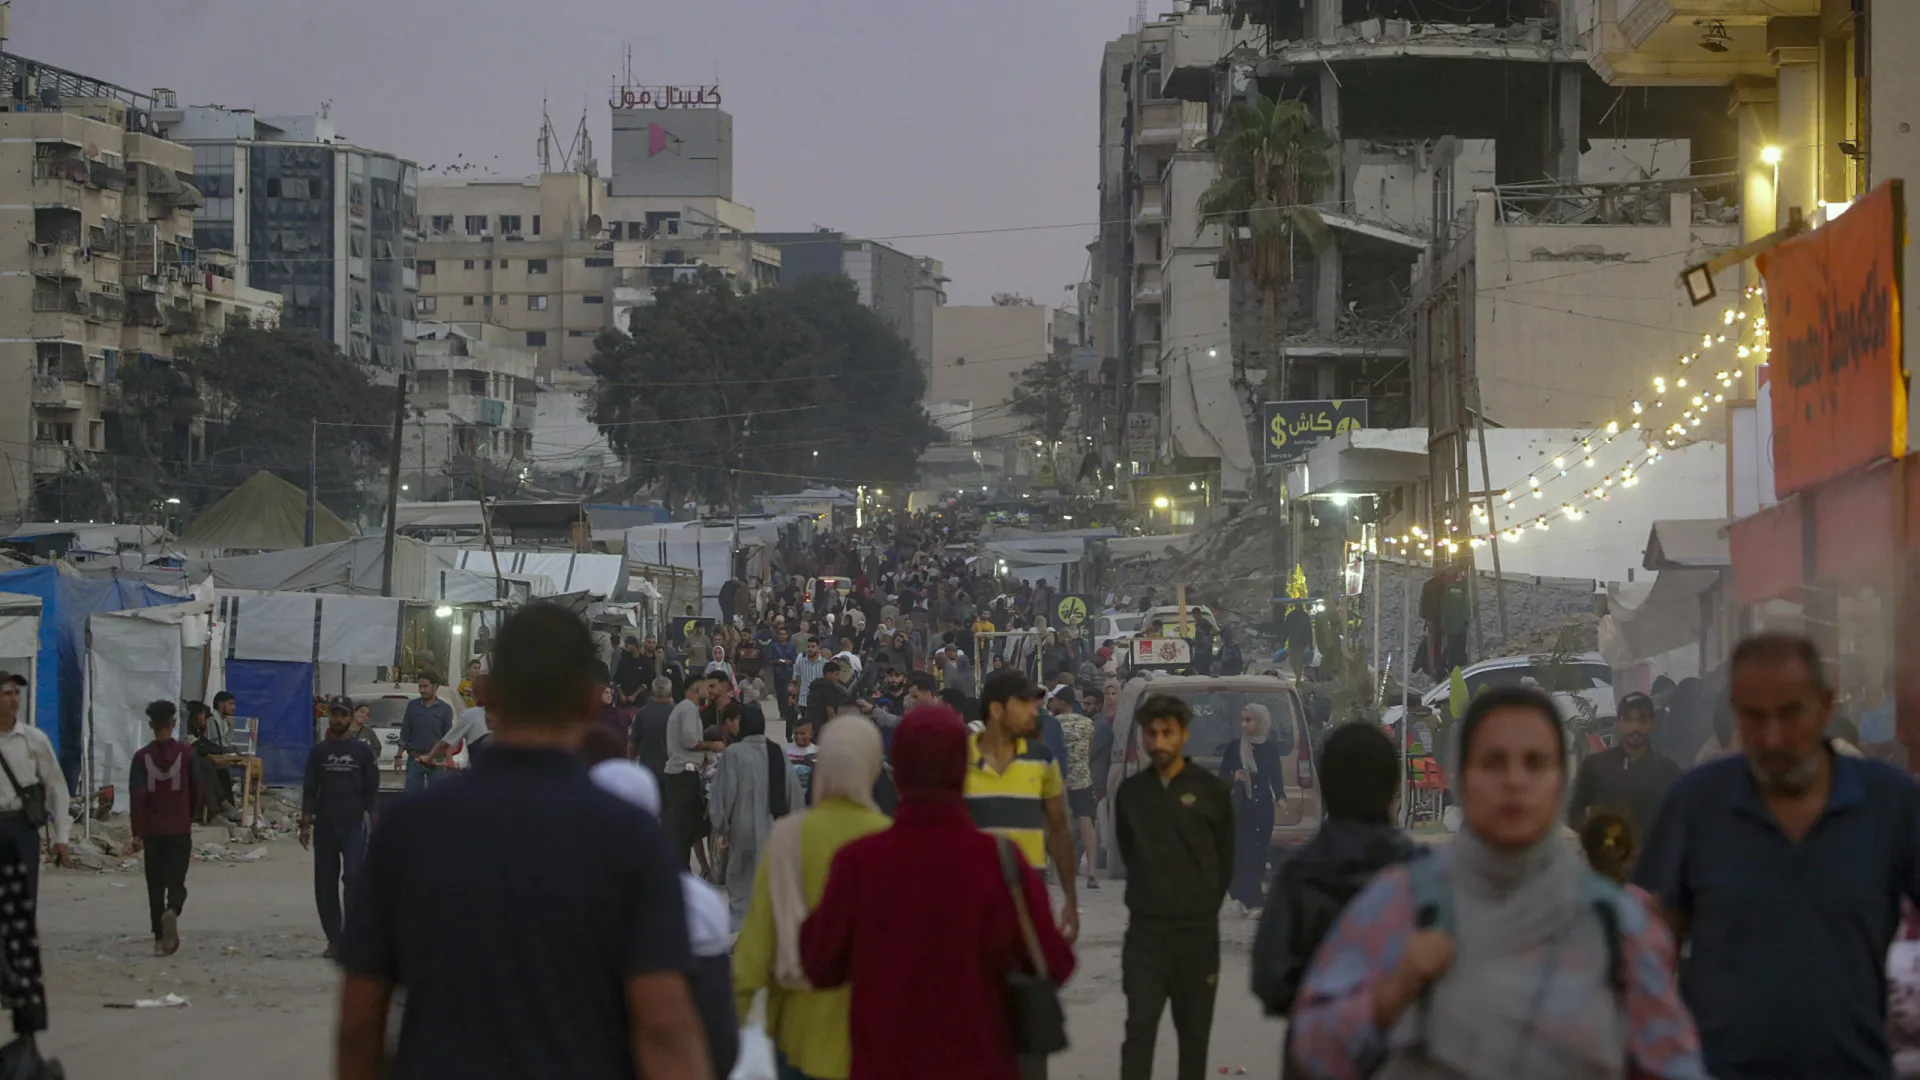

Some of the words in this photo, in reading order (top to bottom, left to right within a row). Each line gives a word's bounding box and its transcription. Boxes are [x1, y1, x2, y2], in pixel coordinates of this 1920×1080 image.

[608, 85, 651, 109] مول
[654, 85, 722, 109] كابيتال
[1270, 413, 1287, 449] $
[1288, 411, 1333, 436] كاش
